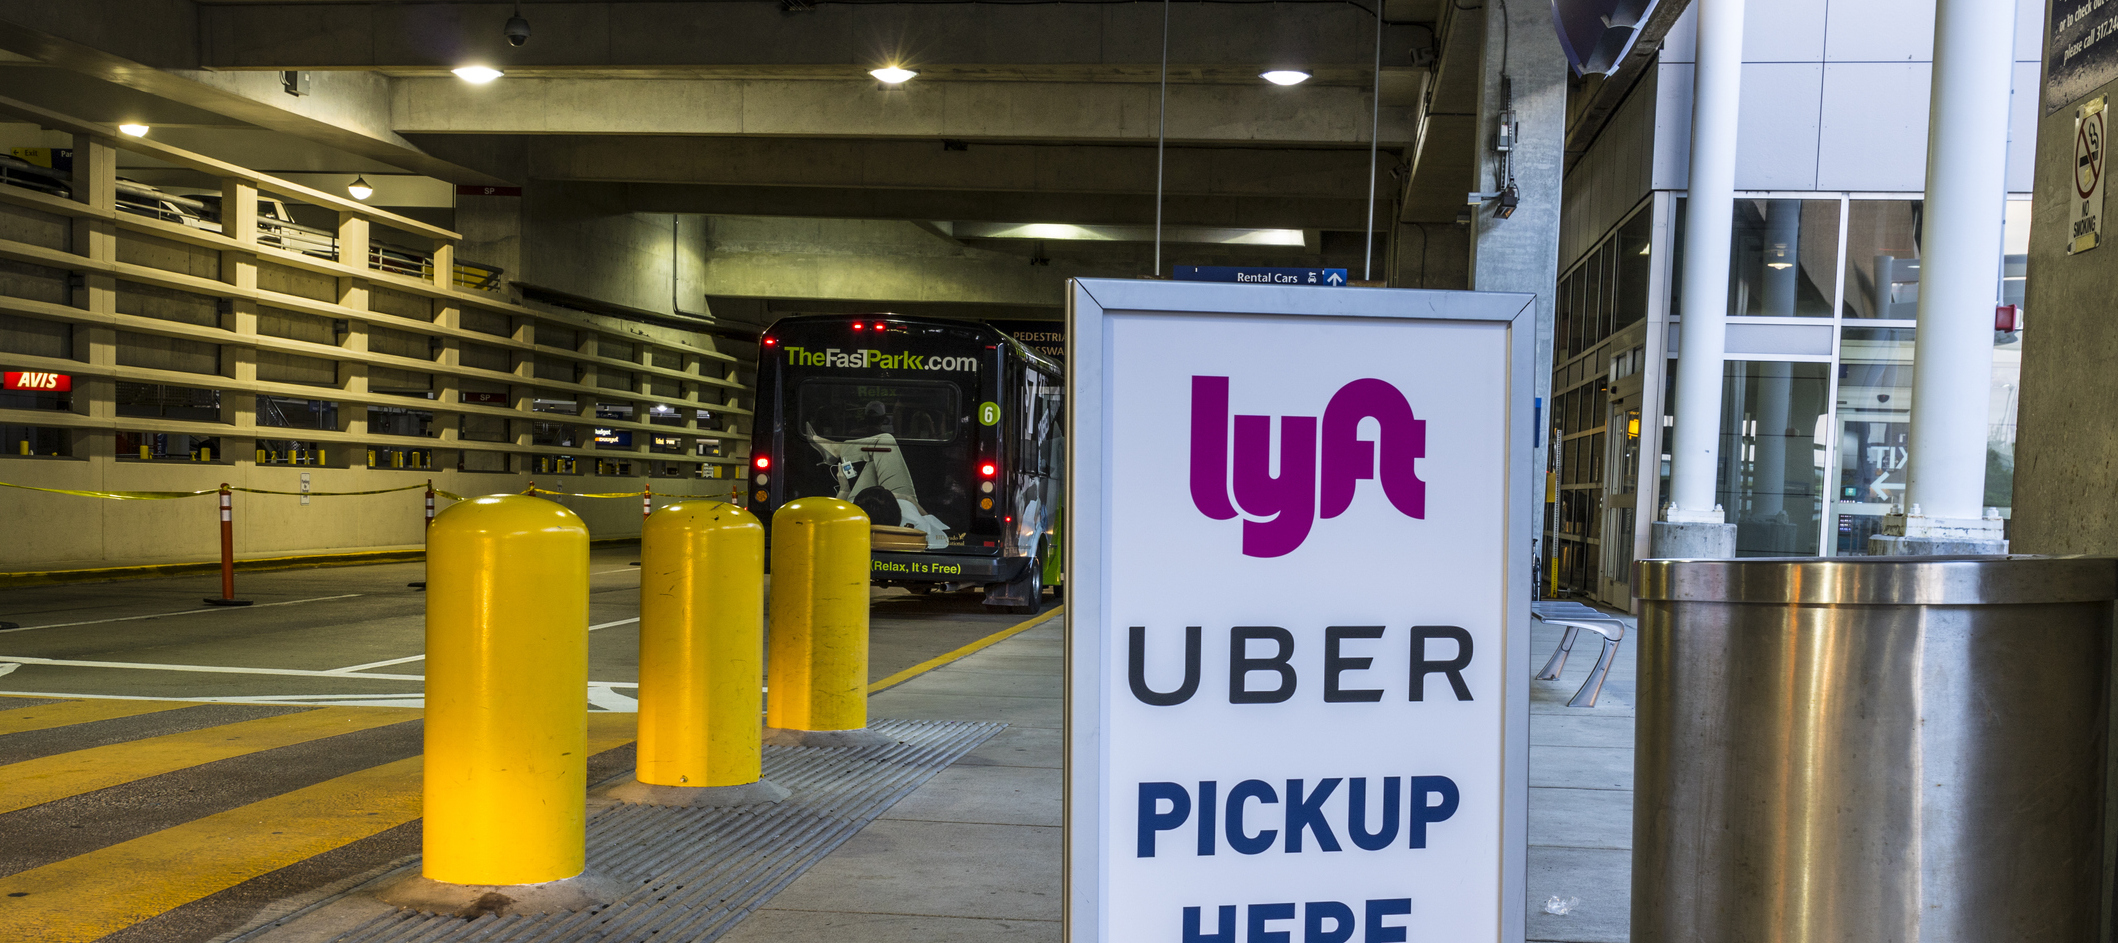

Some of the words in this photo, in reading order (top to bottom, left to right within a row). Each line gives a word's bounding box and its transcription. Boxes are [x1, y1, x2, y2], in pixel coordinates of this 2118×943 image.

[2059, 19, 2067, 32] or
[2067, 14, 2073, 27] to
[2074, 0, 2092, 22] check
[2064, 41, 2082, 66] please
[2083, 28, 2095, 48] call
[2095, 14, 2118, 42] 317.24
[484, 187, 495, 195] SP
[2082, 200, 2089, 217] NO
[2073, 215, 2095, 238] SMOKING
[1237, 272, 1272, 283] Rental
[1274, 273, 1298, 284] Cars
[17, 371, 59, 389] AVIS
[857, 385, 897, 397] Relax
[984, 406, 994, 423] 6
[1189, 374, 1427, 559] lyft
[870, 560, 909, 574] (Relax,
[911, 562, 929, 574] It's
[931, 562, 961, 575] Free)
[1127, 625, 1475, 707] UBER
[1137, 774, 1460, 858] PICKUP
